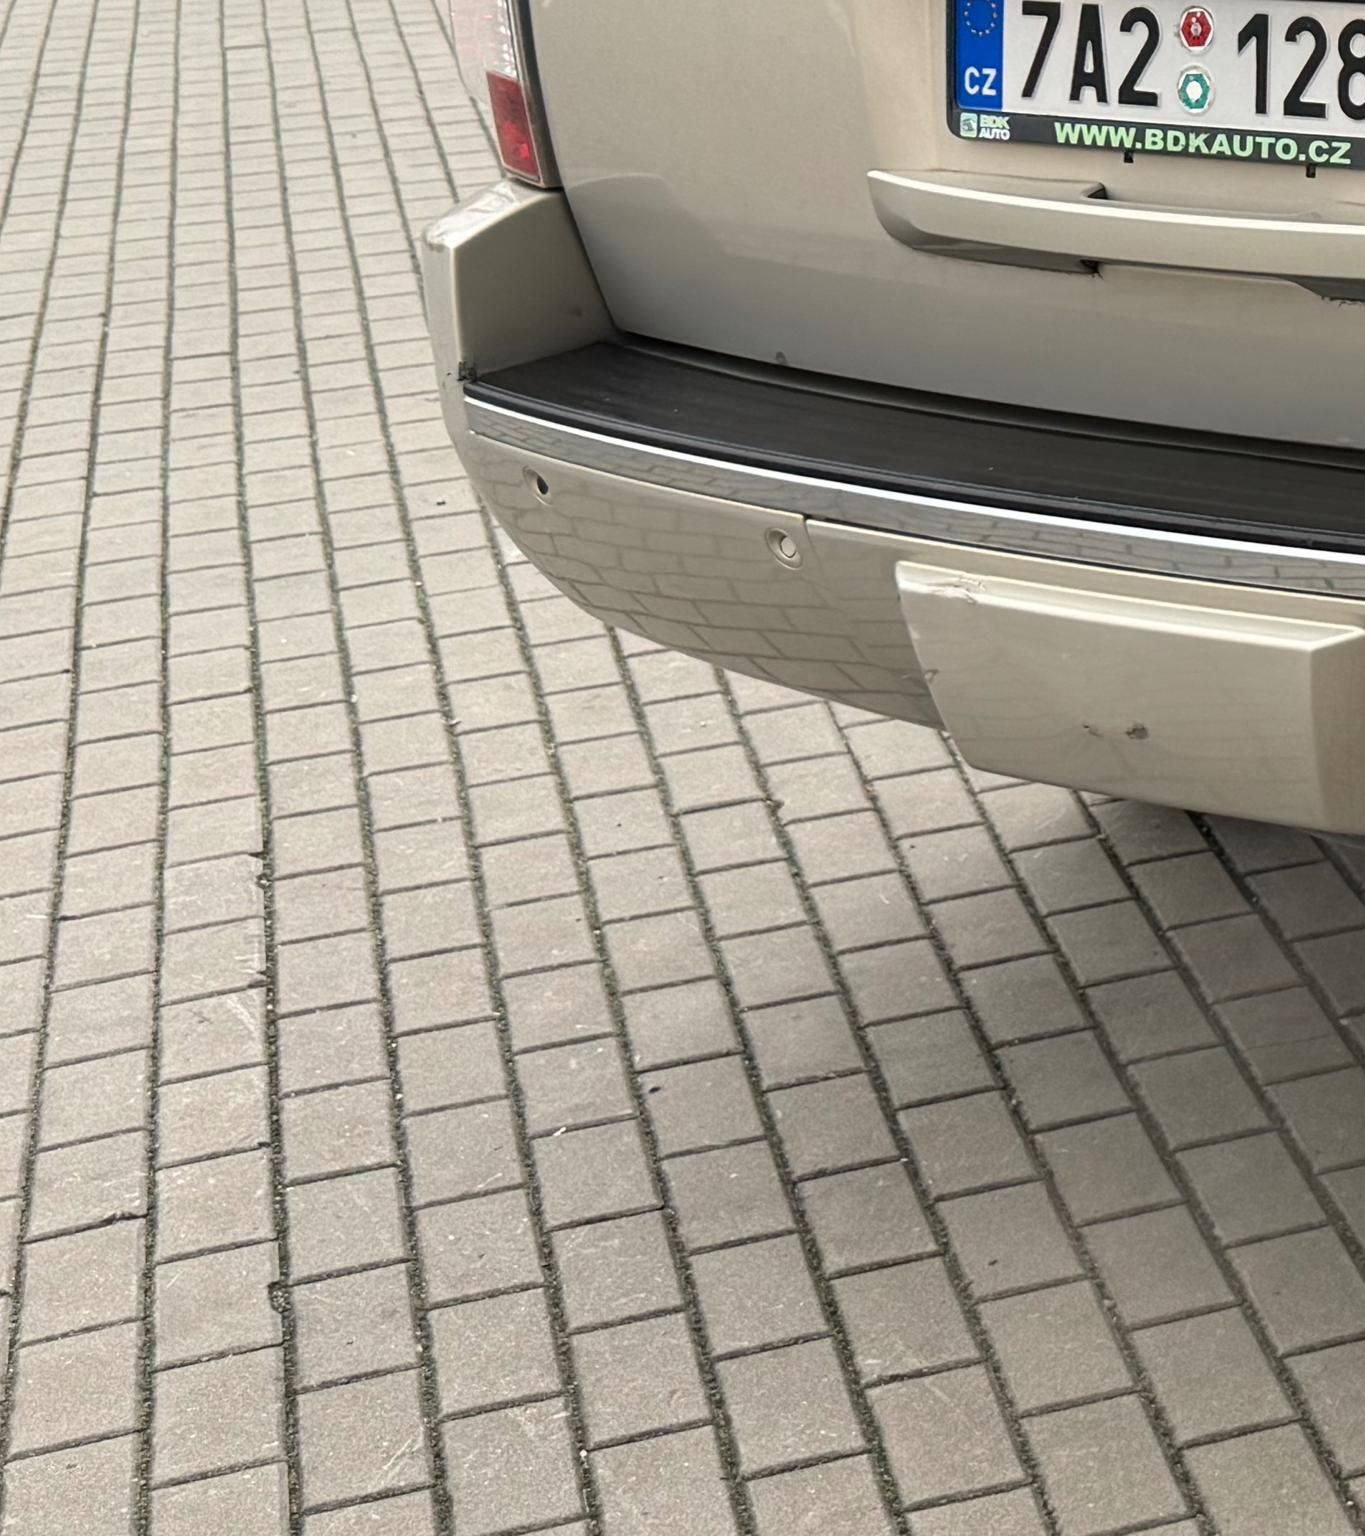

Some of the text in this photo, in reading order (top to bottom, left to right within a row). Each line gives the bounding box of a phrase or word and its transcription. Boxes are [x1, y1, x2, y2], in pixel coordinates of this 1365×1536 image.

[1021, 0, 1160, 107] 7A2
[964, 66, 997, 96] CZ
[978, 128, 1011, 141] AUTO
[979, 114, 1010, 129] BDK
[1054, 121, 1351, 164] WWW.BDKAUTO.CZ
